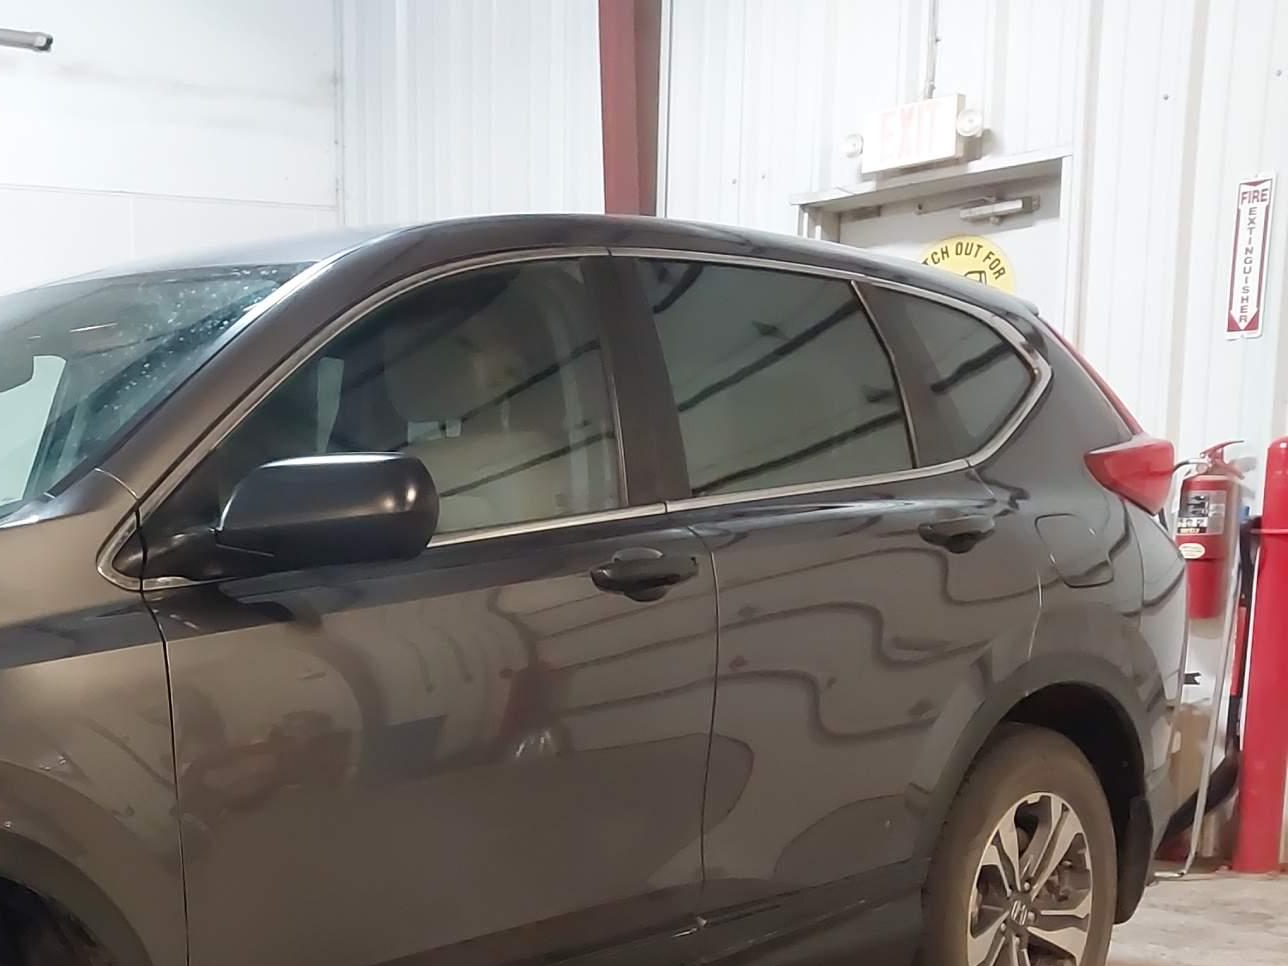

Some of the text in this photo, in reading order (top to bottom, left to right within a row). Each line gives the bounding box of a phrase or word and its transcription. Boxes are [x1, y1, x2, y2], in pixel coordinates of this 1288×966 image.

[880, 101, 940, 163] EXIT
[1240, 188, 1269, 205] FIRE
[920, 241, 1006, 280] TCH OUT FOR
[1238, 206, 1258, 324] EXTINGUISHER
